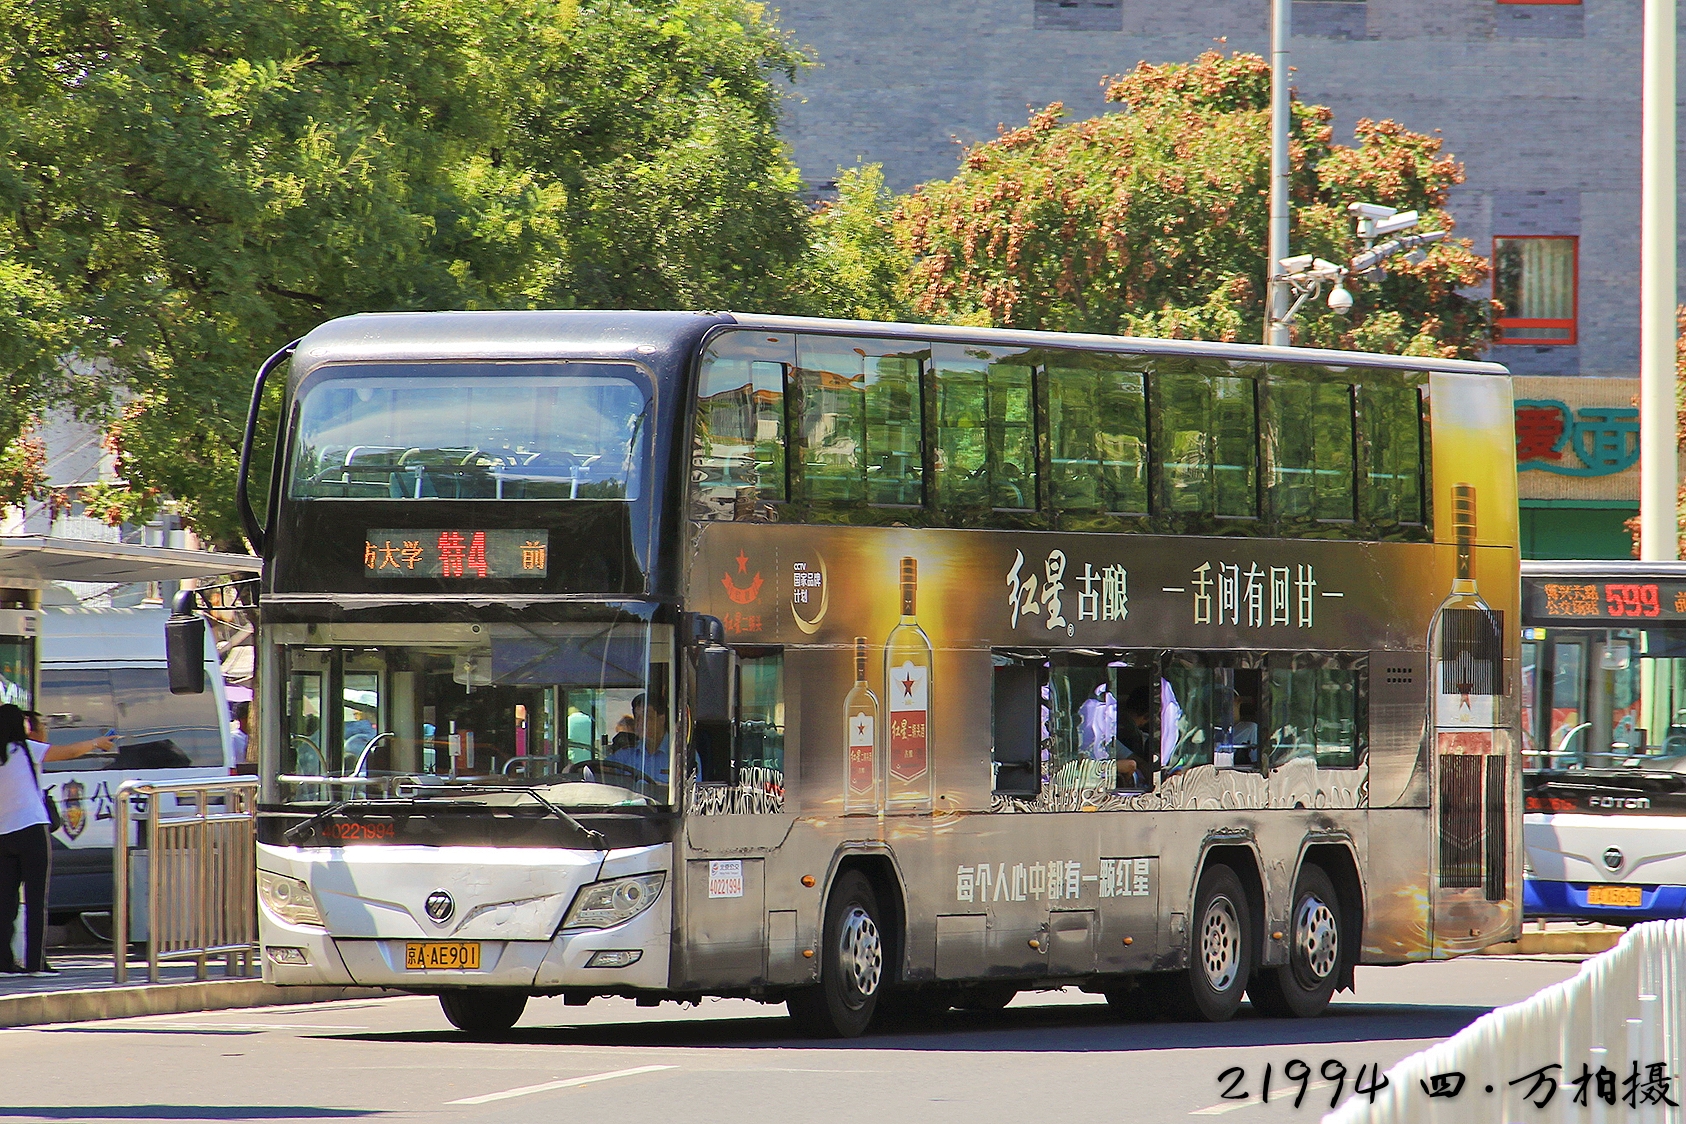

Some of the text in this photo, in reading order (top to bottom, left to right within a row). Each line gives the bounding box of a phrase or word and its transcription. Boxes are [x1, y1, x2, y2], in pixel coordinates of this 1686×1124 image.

[436, 531, 488, 578] 特4
[519, 540, 547, 570] 前
[793, 572, 822, 587] 国家品牌
[793, 589, 808, 603] 计划
[1604, 583, 1661, 617] 599
[1588, 795, 1651, 809] FOTON
[322, 822, 395, 839] 40221994
[710, 878, 741, 895] 40221994
[956, 859, 1150, 903] 每个人心中都有一颗红星
